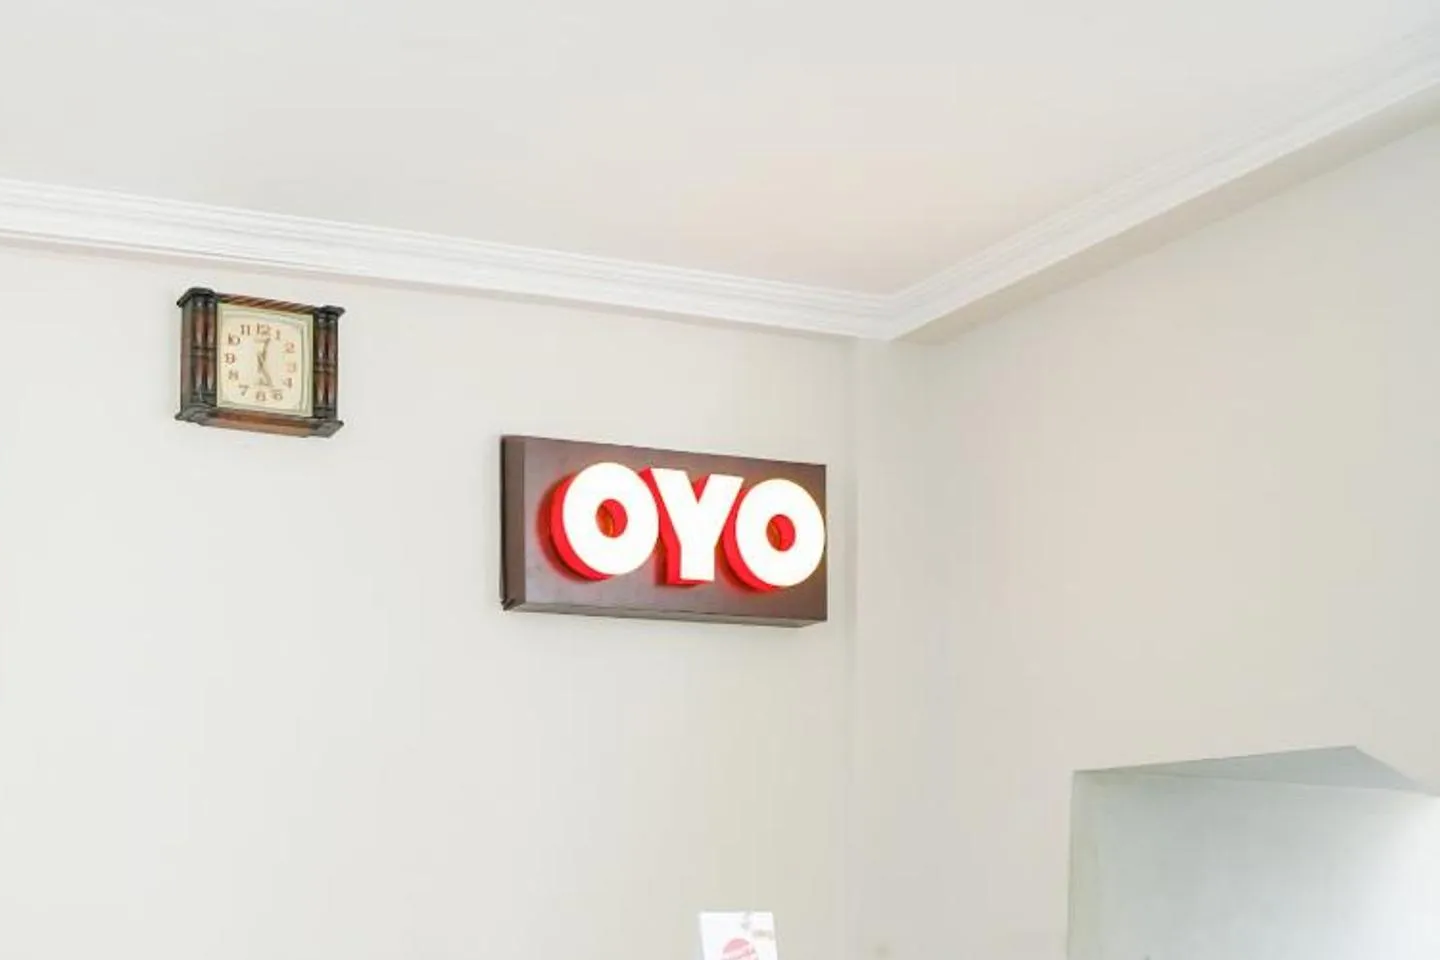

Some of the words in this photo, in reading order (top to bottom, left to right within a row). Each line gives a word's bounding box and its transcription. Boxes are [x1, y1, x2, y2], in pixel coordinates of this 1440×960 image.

[240, 324, 251, 336] 11
[256, 323, 270, 335] 12
[275, 330, 281, 341] 1
[284, 342, 295, 353] 2
[282, 377, 293, 389] 4
[238, 385, 250, 397] 7
[552, 462, 826, 591] OYO
